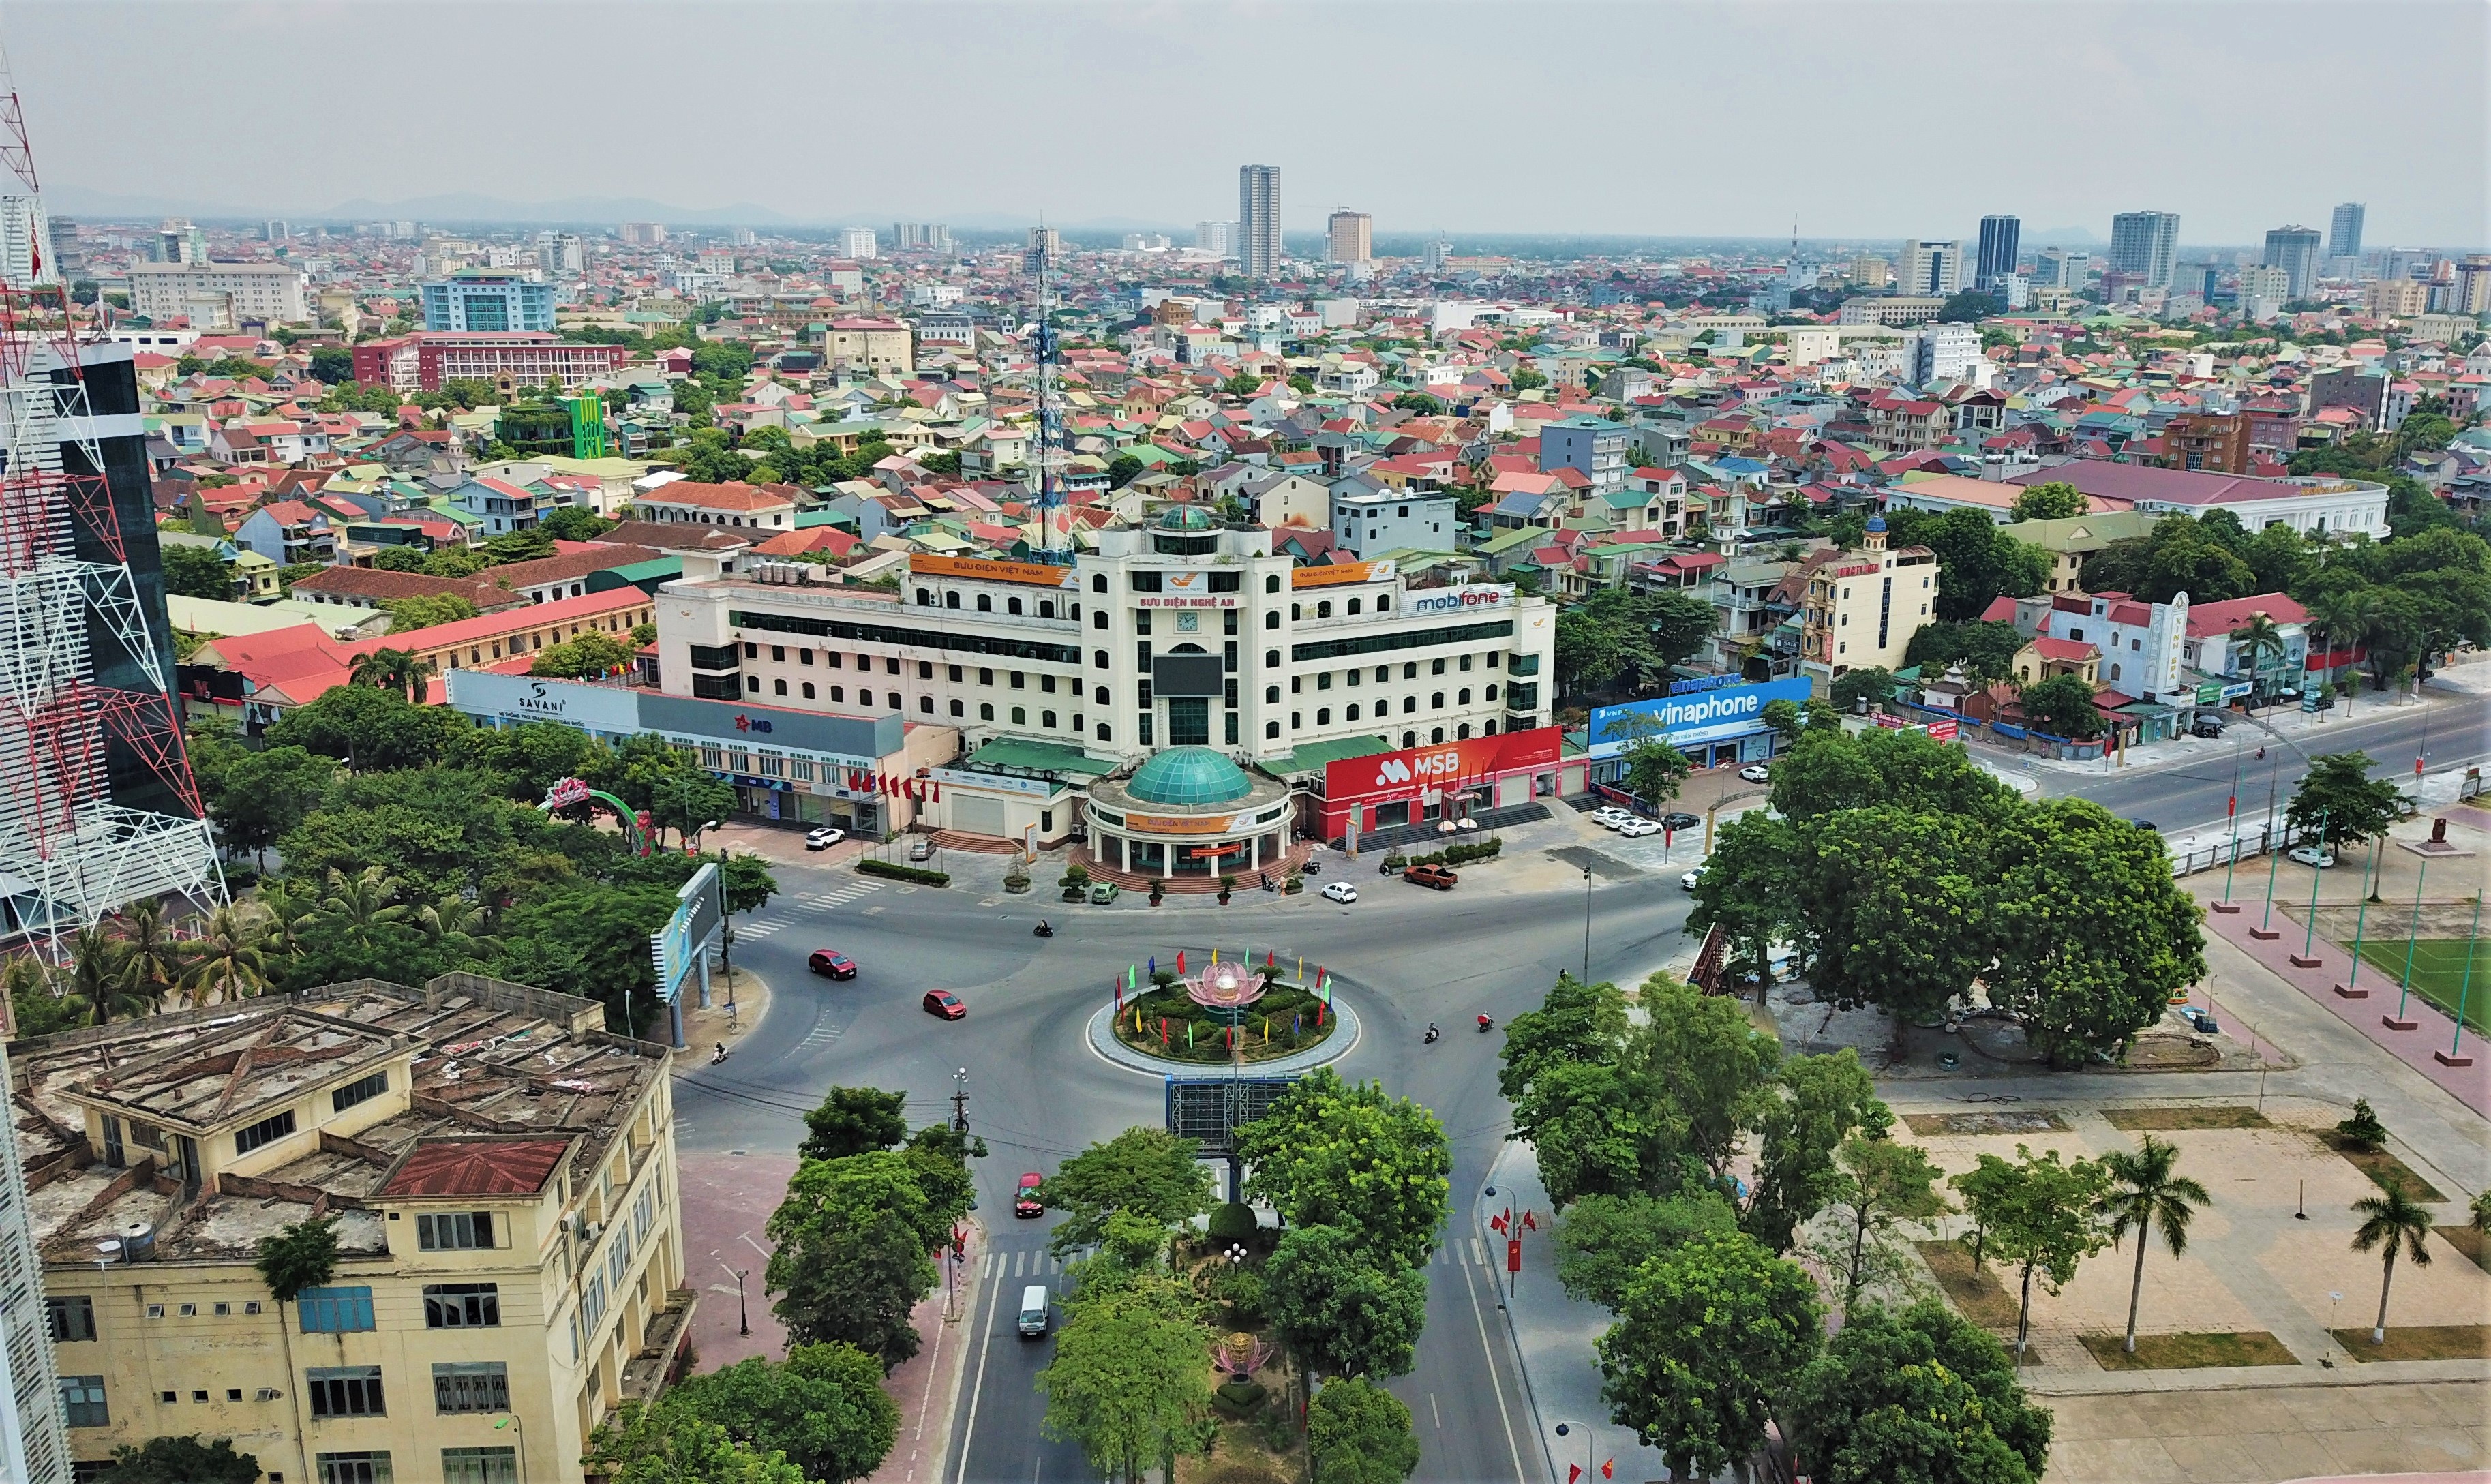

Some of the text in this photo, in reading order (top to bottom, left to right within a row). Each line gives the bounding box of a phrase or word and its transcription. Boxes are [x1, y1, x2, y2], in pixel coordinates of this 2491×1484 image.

[954, 562, 973, 570] BƯU
[975, 562, 997, 573] ĐIỆN
[1000, 565, 1021, 575] VIỆT
[1023, 568, 1044, 576] NAM
[1140, 596, 1235, 608] BƯU ĐIỆN NGHỆ AN
[1417, 590, 1500, 611] mobifone
[2169, 618, 2181, 680] XINH SPA
[1670, 672, 1742, 694] vinaphone
[519, 698, 563, 712] SAVANI
[1607, 709, 1629, 717] VNP
[1653, 695, 1757, 725] vinaphone
[751, 719, 772, 733] MB
[1415, 753, 1459, 778] MSB
